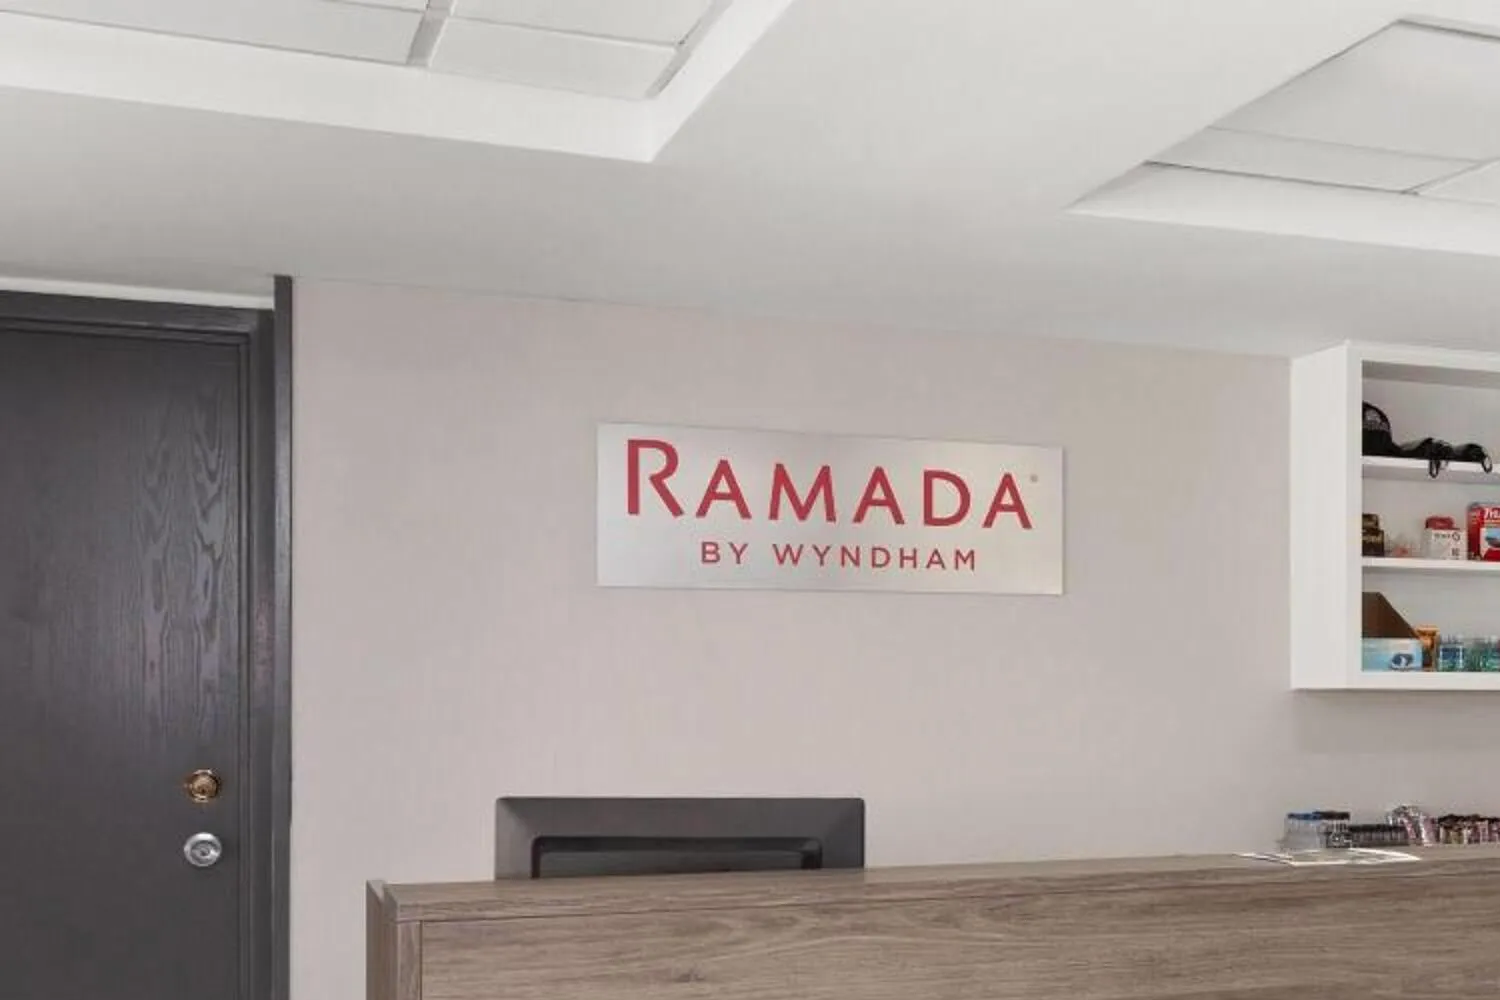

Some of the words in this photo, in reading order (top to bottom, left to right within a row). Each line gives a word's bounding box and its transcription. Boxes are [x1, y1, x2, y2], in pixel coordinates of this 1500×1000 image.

[626, 438, 1033, 529] RAMADA
[701, 541, 749, 565] BY
[772, 542, 977, 571] WYNDHAM
